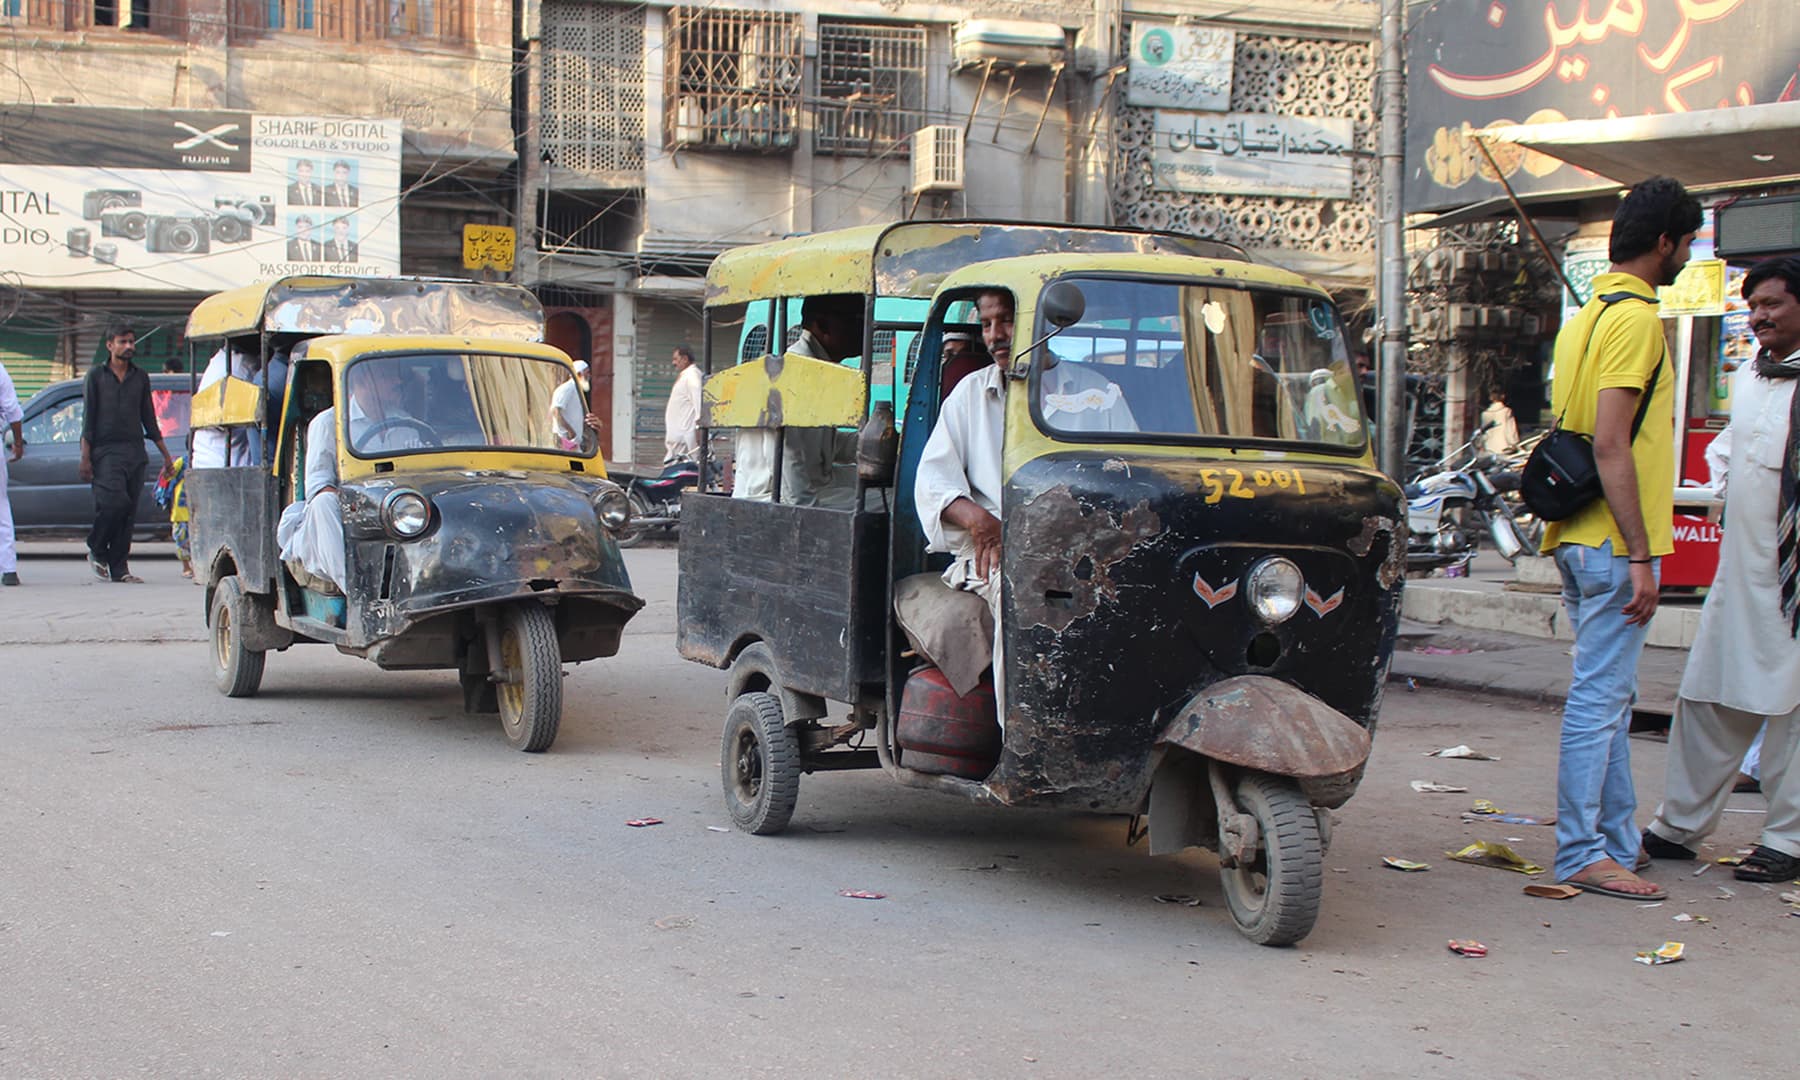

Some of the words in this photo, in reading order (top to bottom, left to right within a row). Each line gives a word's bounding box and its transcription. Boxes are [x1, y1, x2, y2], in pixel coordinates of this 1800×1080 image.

[258, 119, 318, 136] SHARIF
[323, 122, 388, 139] DIGITAL
[1168, 117, 1219, 153] خان
[1222, 119, 1287, 156] اشتیاق
[255, 137, 299, 148] COLOR
[302, 139, 327, 150] LAB
[329, 140, 339, 150] &
[342, 140, 391, 152] STUDIO
[181, 155, 231, 164] FUJIFILM
[0, 190, 60, 215] ITAL
[3, 227, 50, 245] DIO
[259, 263, 326, 275] PASSPORT
[329, 264, 381, 275] SERVICE
